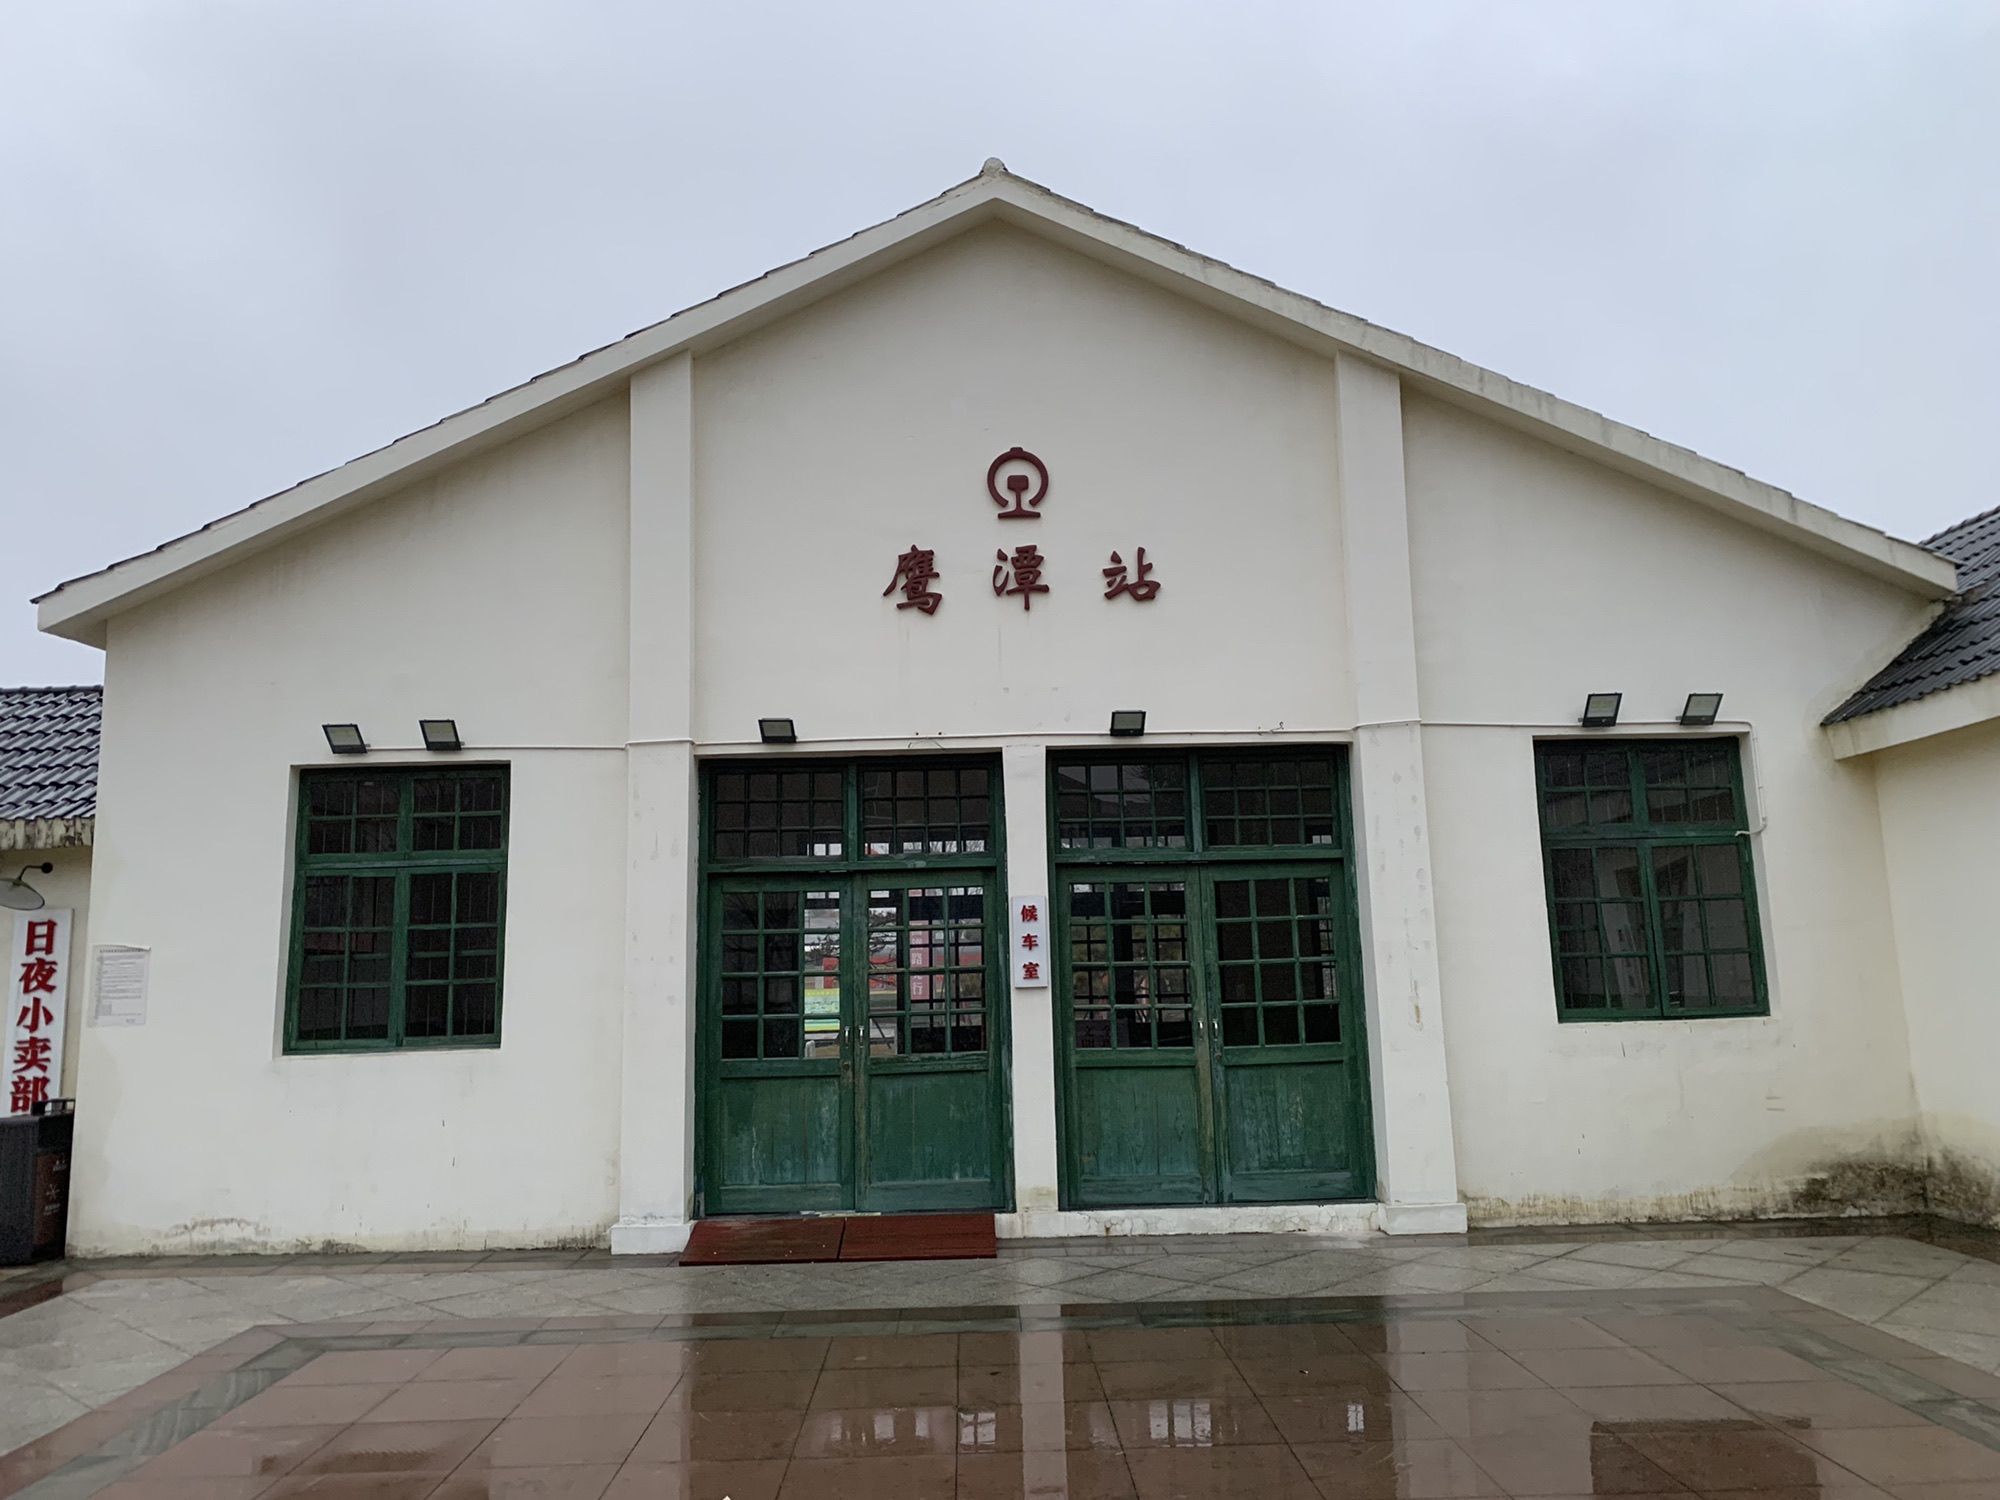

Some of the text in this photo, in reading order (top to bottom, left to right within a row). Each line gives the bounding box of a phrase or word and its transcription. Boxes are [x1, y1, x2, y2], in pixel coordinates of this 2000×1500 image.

[883, 544, 1161, 615] 鹰潭站
[1021, 904, 1040, 980] 候车室
[10, 919, 58, 1113] 日夜小卖部
